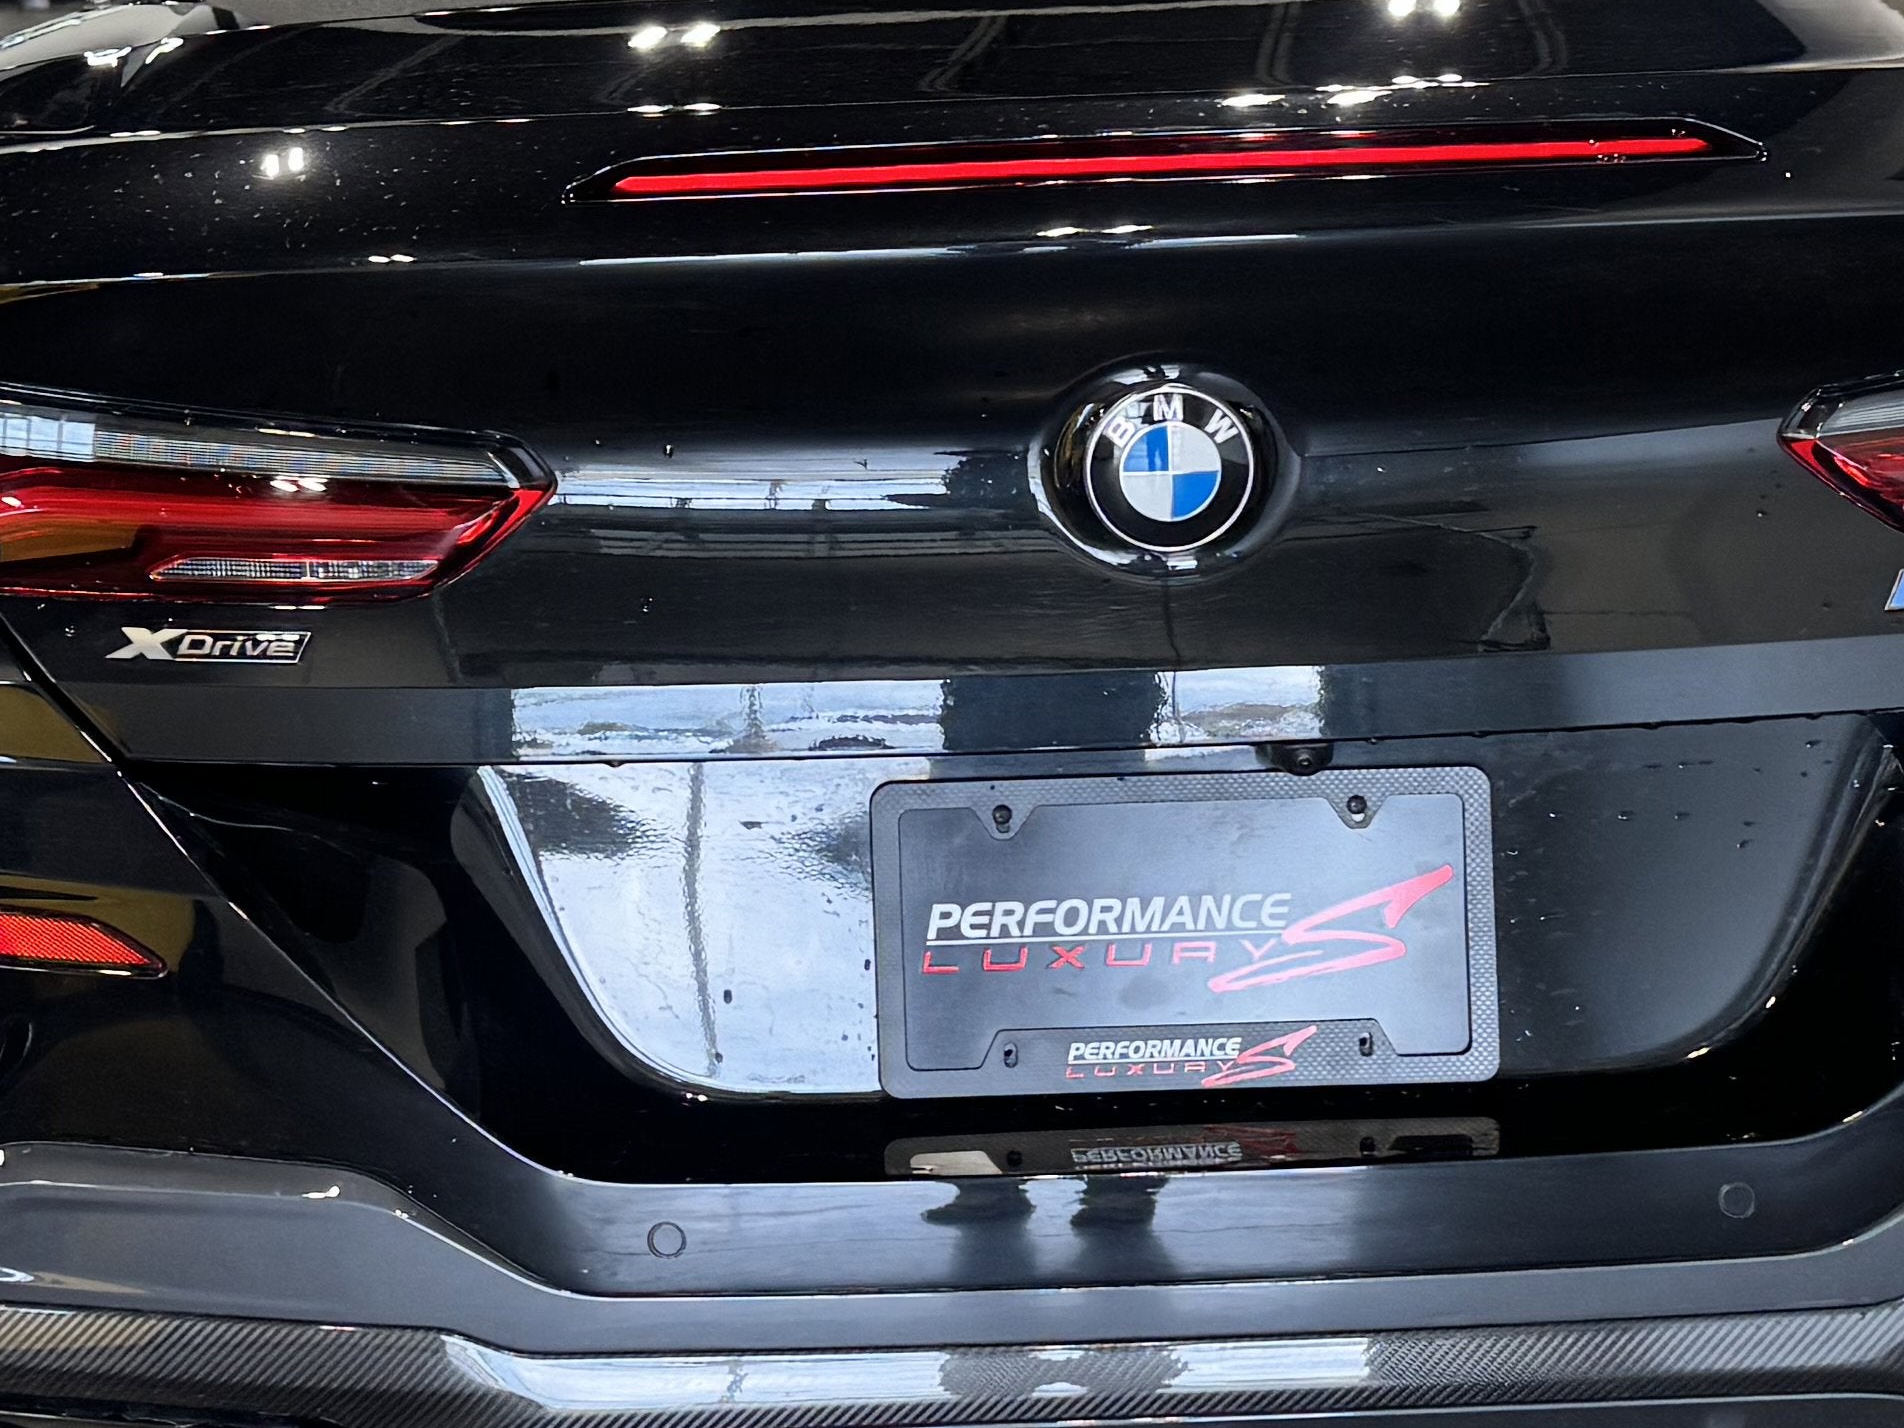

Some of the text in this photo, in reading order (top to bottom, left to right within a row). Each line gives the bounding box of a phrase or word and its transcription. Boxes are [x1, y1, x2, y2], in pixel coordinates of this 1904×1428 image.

[1102, 393, 1239, 448] BMW
[926, 892, 1292, 941] PERFORMANCE
[921, 937, 1286, 974] LUXURY
[1067, 1036, 1243, 1062] PERFORMANCE
[1065, 1059, 1236, 1079] LUXURY
